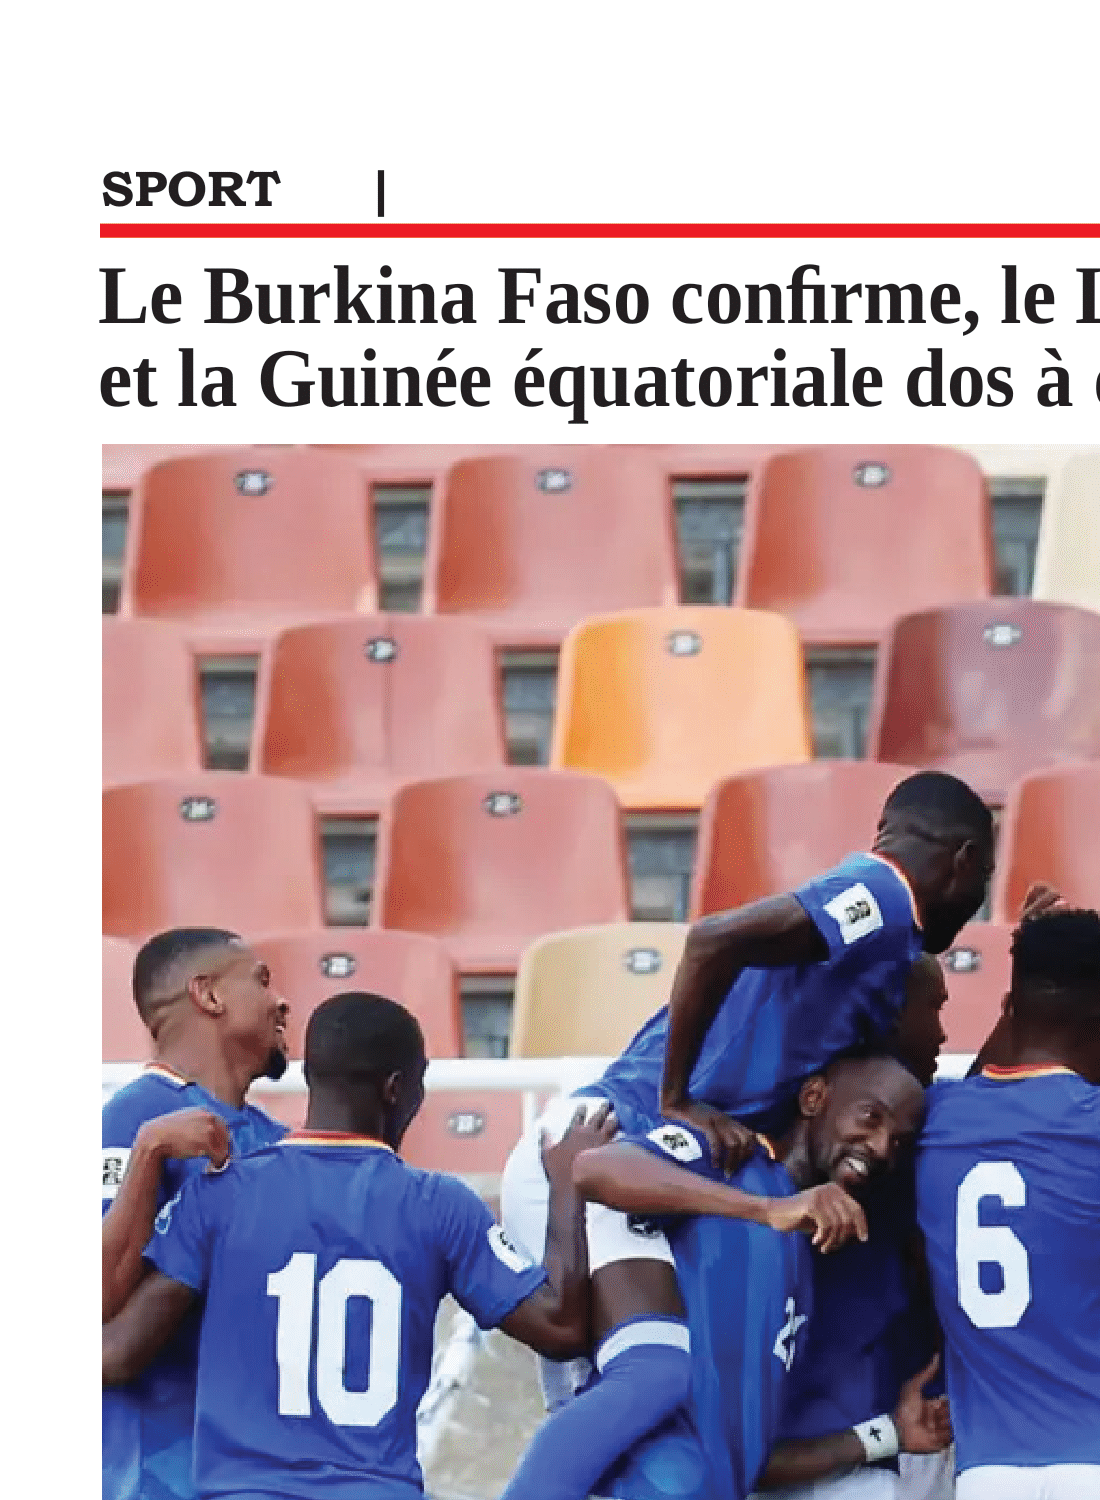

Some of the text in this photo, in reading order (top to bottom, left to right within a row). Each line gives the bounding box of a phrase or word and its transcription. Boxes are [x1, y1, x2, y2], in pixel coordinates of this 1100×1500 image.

[102, 170, 282, 208] SPORT
[98, 267, 182, 325] Le
[203, 264, 477, 325] Burkina
[497, 267, 650, 325] Faso
[672, 263, 979, 337] confirme,
[1000, 264, 1055, 325] le
[100, 358, 158, 408] et
[177, 347, 237, 408] la
[260, 347, 491, 408] Guinée
[514, 347, 883, 425] équatoriale
[906, 347, 1014, 408] dos
[1036, 347, 1073, 408] à
[956, 1160, 1034, 1329] 6
[266, 1251, 403, 1428] 10
